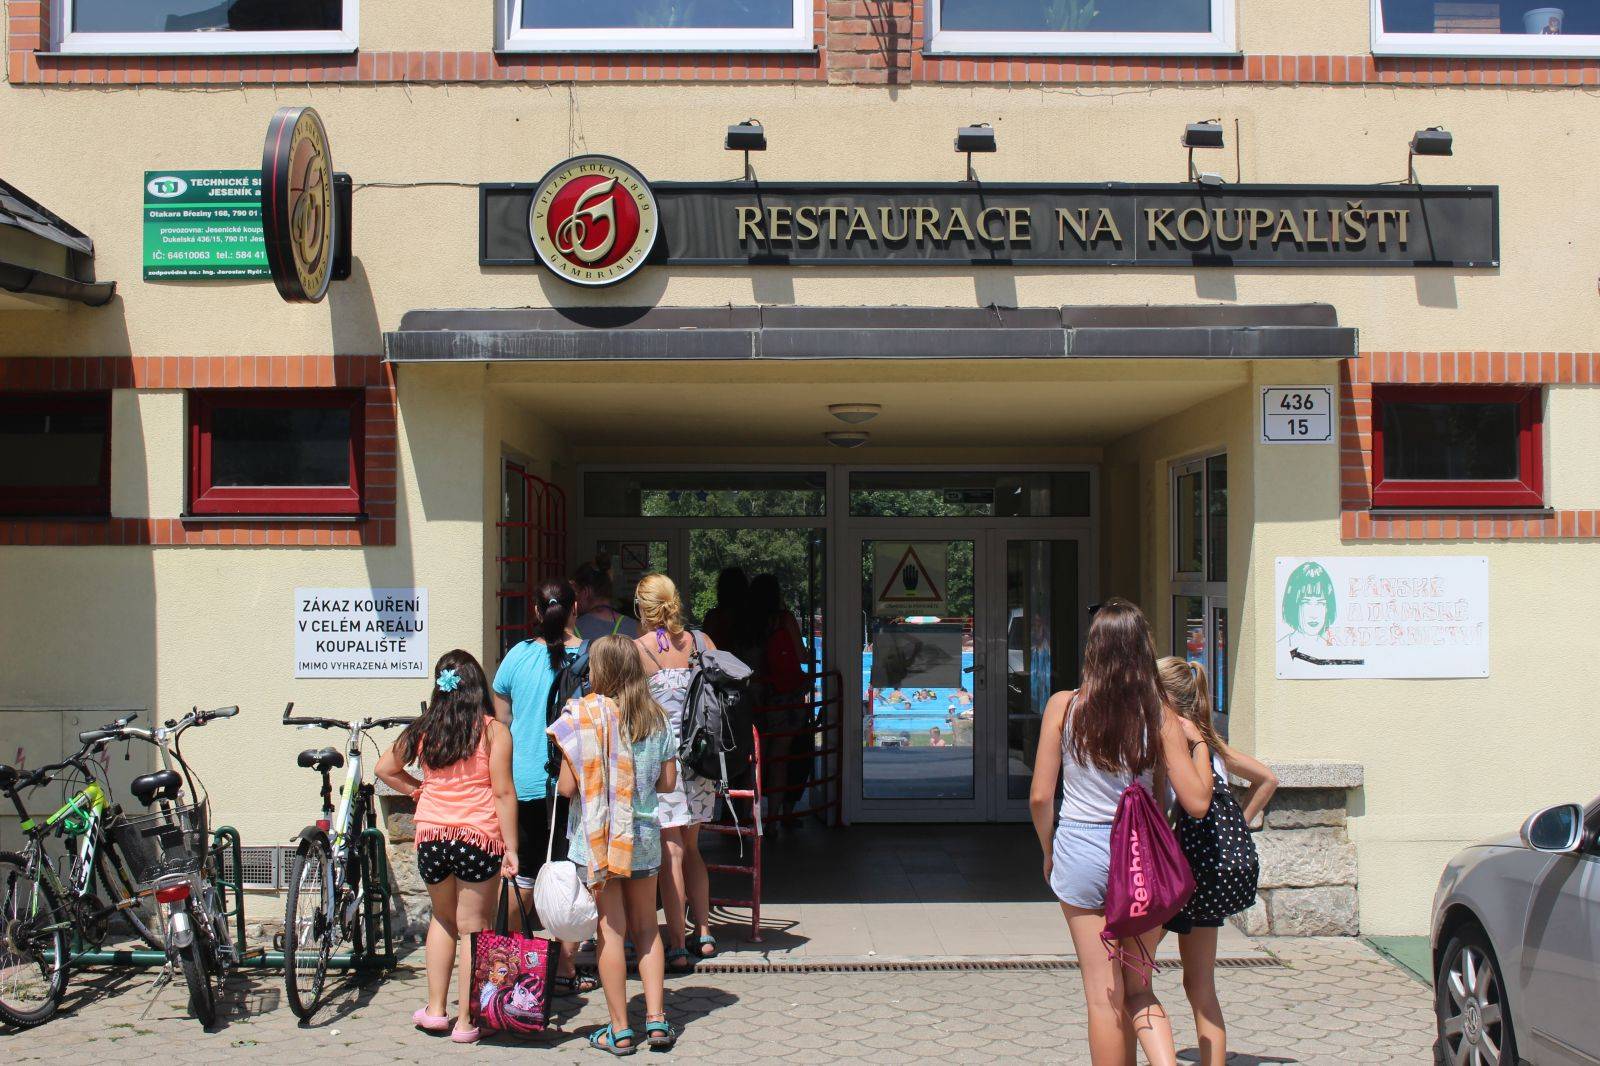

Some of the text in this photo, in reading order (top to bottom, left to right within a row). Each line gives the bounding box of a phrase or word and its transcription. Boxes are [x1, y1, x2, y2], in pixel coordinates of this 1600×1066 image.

[190, 176, 248, 186] TECHNICKÉ
[580, 163, 616, 175] ROKU
[623, 176, 650, 211] 1869
[208, 188, 252, 196] JESENÍK
[183, 210, 212, 218] Březiny
[735, 200, 1410, 243] RESTAURACE NA KOUPALIŠTI
[152, 250, 165, 259] IČ:
[168, 251, 210, 259] 64610063
[550, 247, 642, 279] GAMBRINUS
[1280, 394, 1314, 410] 436
[1288, 419, 1308, 435] 15
[302, 596, 420, 612] ZÁKAZ KOUŘENÍ
[299, 616, 424, 632] V CELÉM AREÁLU
[316, 636, 406, 652] KOUPALIŠTĚ
[298, 660, 422, 670] (MIMO VYHRAZENÁ MÍSTA)
